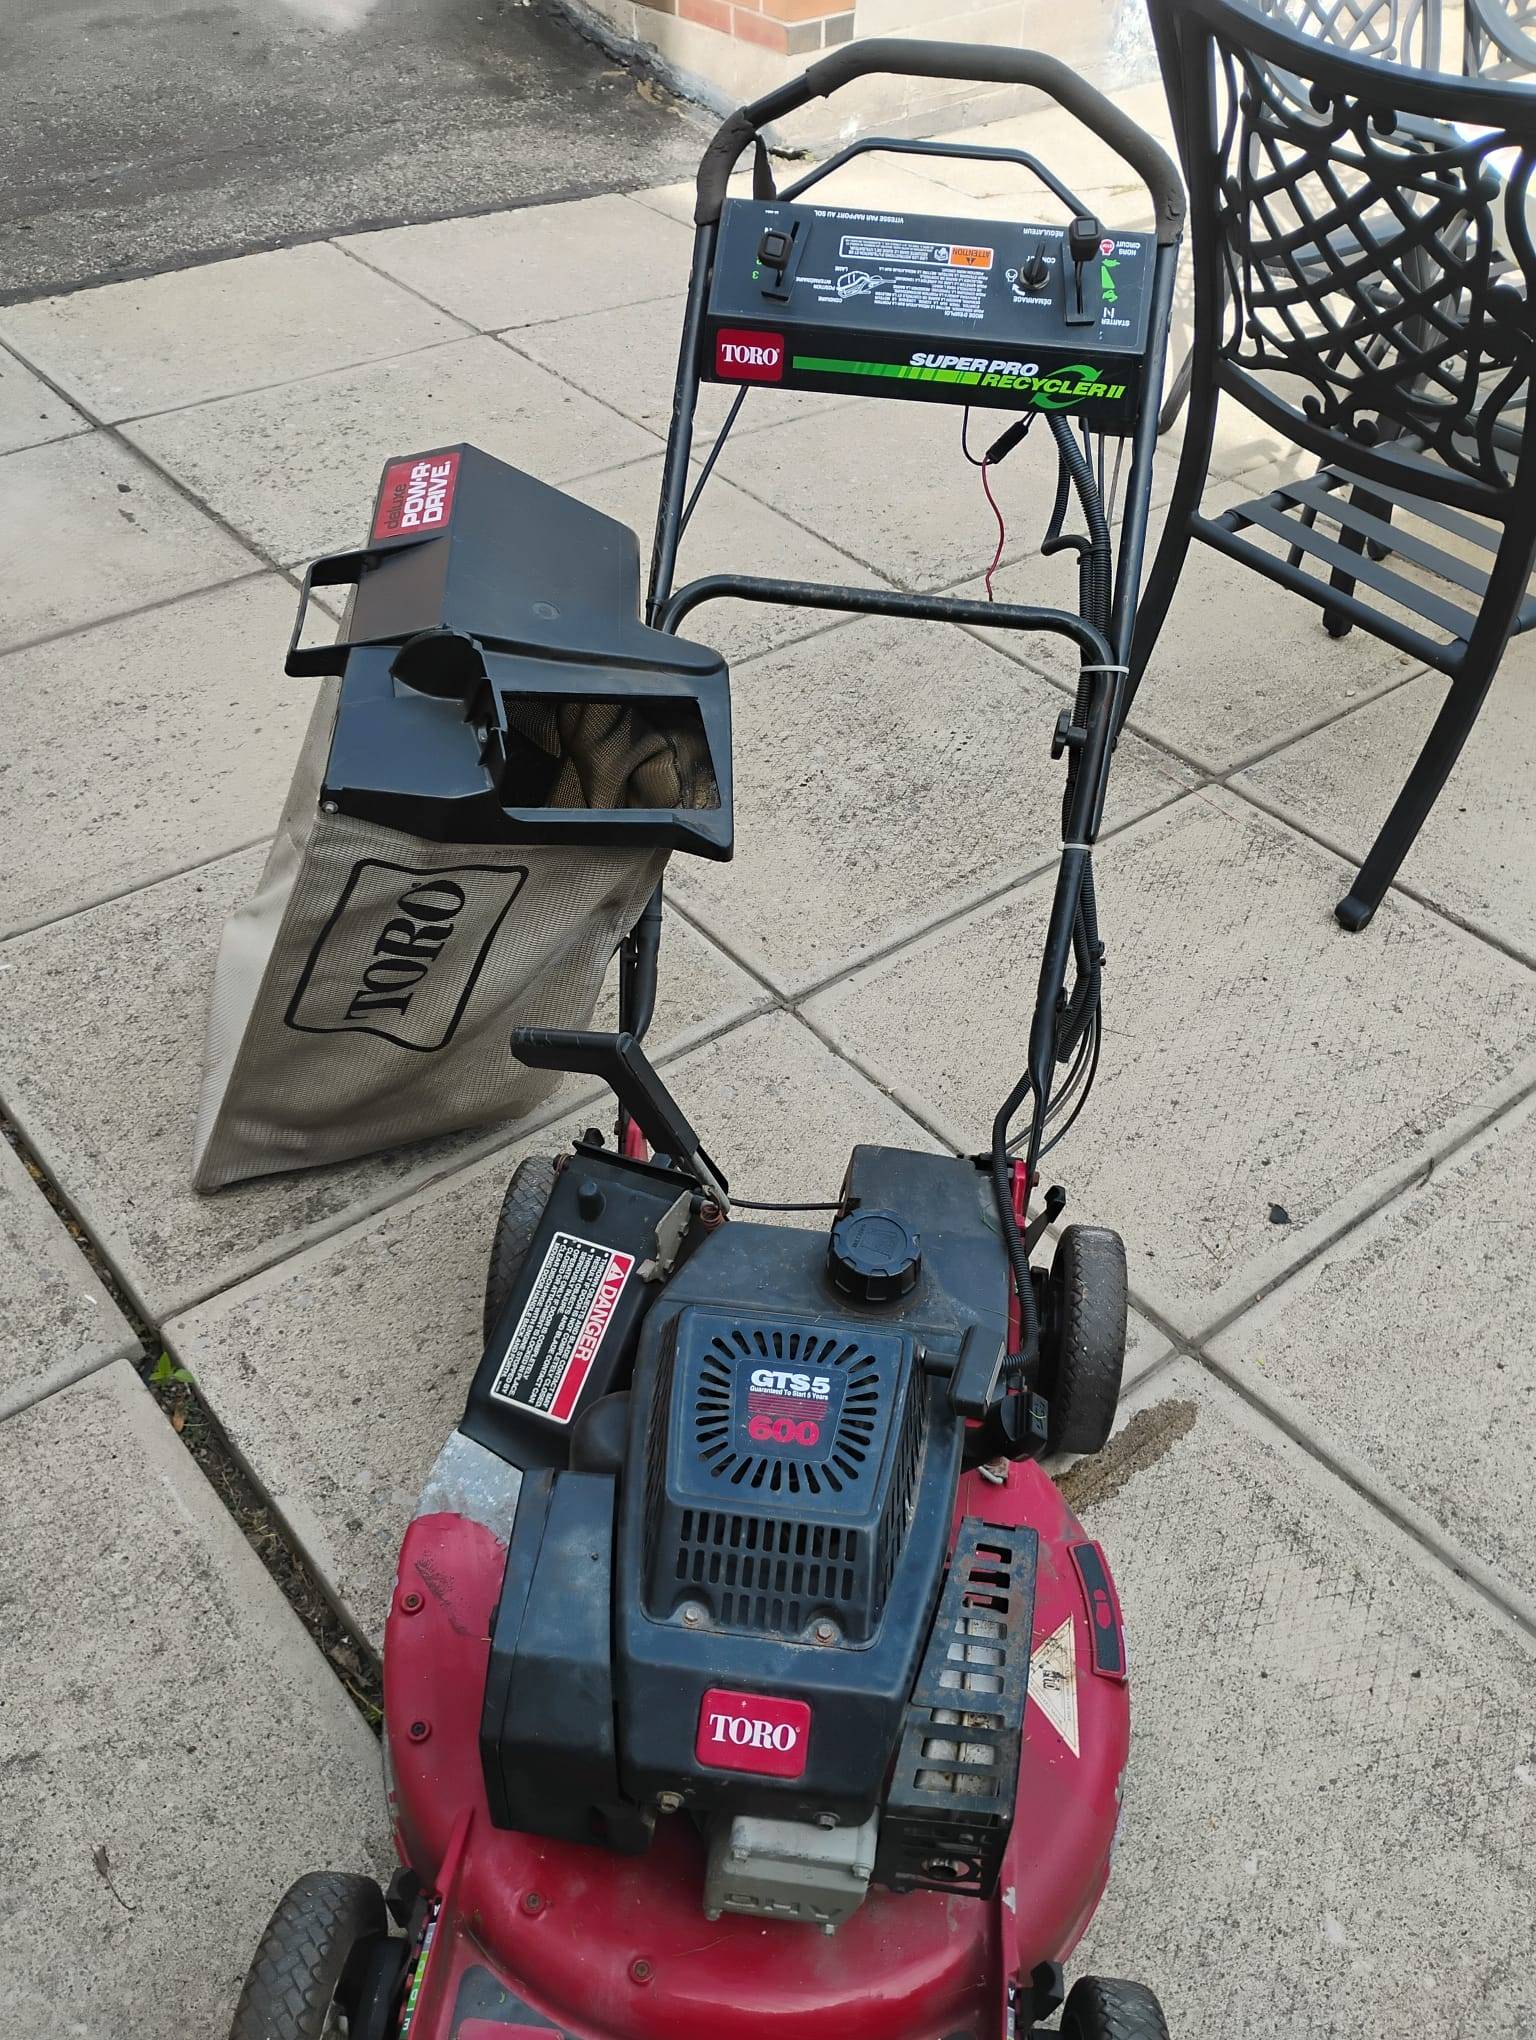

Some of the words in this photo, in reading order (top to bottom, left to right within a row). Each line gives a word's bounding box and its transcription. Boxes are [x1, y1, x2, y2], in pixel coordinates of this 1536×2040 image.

[836, 211, 865, 220] RAPPORT
[879, 215, 904, 223] VITESSE
[952, 248, 990, 258] ATTENTION
[1115, 240, 1140, 249] CIRCUIT
[1118, 248, 1136, 256] HORS
[751, 270, 759, 279] 3
[1100, 318, 1130, 326] STARTER
[721, 344, 778, 366] TORO
[909, 352, 988, 372] SUPER
[988, 360, 1040, 377] PRO
[981, 373, 1109, 397] RECYCLER
[1107, 385, 1127, 399] II
[384, 483, 407, 529] deluxe
[344, 880, 466, 1020] TORO
[544, 1241, 560, 1269] MOVING
[552, 1243, 566, 1268] CLEAR
[557, 1245, 573, 1274] CLOSED
[562, 1247, 580, 1280] OPERATE
[576, 1252, 593, 1283] THROWN
[536, 1268, 549, 1290] DOOR
[567, 1250, 587, 1288] SERIOUSLY
[585, 1255, 601, 1282] RESULT
[590, 1257, 607, 1288] THROWN
[536, 1266, 557, 1307] DISCHARGE
[554, 1279, 567, 1298] ONLY
[563, 1282, 581, 1315] OBJECTS
[574, 1288, 587, 1310] DOOR
[524, 1288, 541, 1318] HANDLE
[529, 1306, 541, 1325] WITH
[535, 1284, 558, 1329] ATTACHMENT
[543, 1305, 557, 1327] DOOR
[577, 1287, 595, 1320] OBJECTS
[517, 1317, 529, 1337] BACK
[557, 1314, 568, 1331] AND
[565, 1316, 576, 1332] NOT
[571, 1319, 582, 1335] AND
[574, 1283, 618, 1362] DANGER
[510, 1336, 521, 1353] AND
[518, 1324, 534, 1352] ENGINE
[520, 1335, 537, 1365] LOCKED
[547, 1329, 562, 1355] BLADE
[561, 1334, 576, 1360] BLADE
[505, 1350, 523, 1383] STOPPED
[521, 1333, 545, 1380] COMPLETELY
[546, 1331, 570, 1378] COMPLETELY
[534, 1353, 552, 1387] CONTACT
[548, 1358, 566, 1393] CONTACT
[527, 1386, 539, 1404] CAN
[541, 1391, 553, 1408] MAY
[749, 1385, 783, 1395] Guaranteed
[784, 1388, 791, 1396] To
[792, 1390, 806, 1398] Start
[812, 1392, 829, 1400] Years
[748, 1414, 819, 1447] 600
[709, 1713, 797, 1752] TORO
[433, 1904, 441, 1916] A
